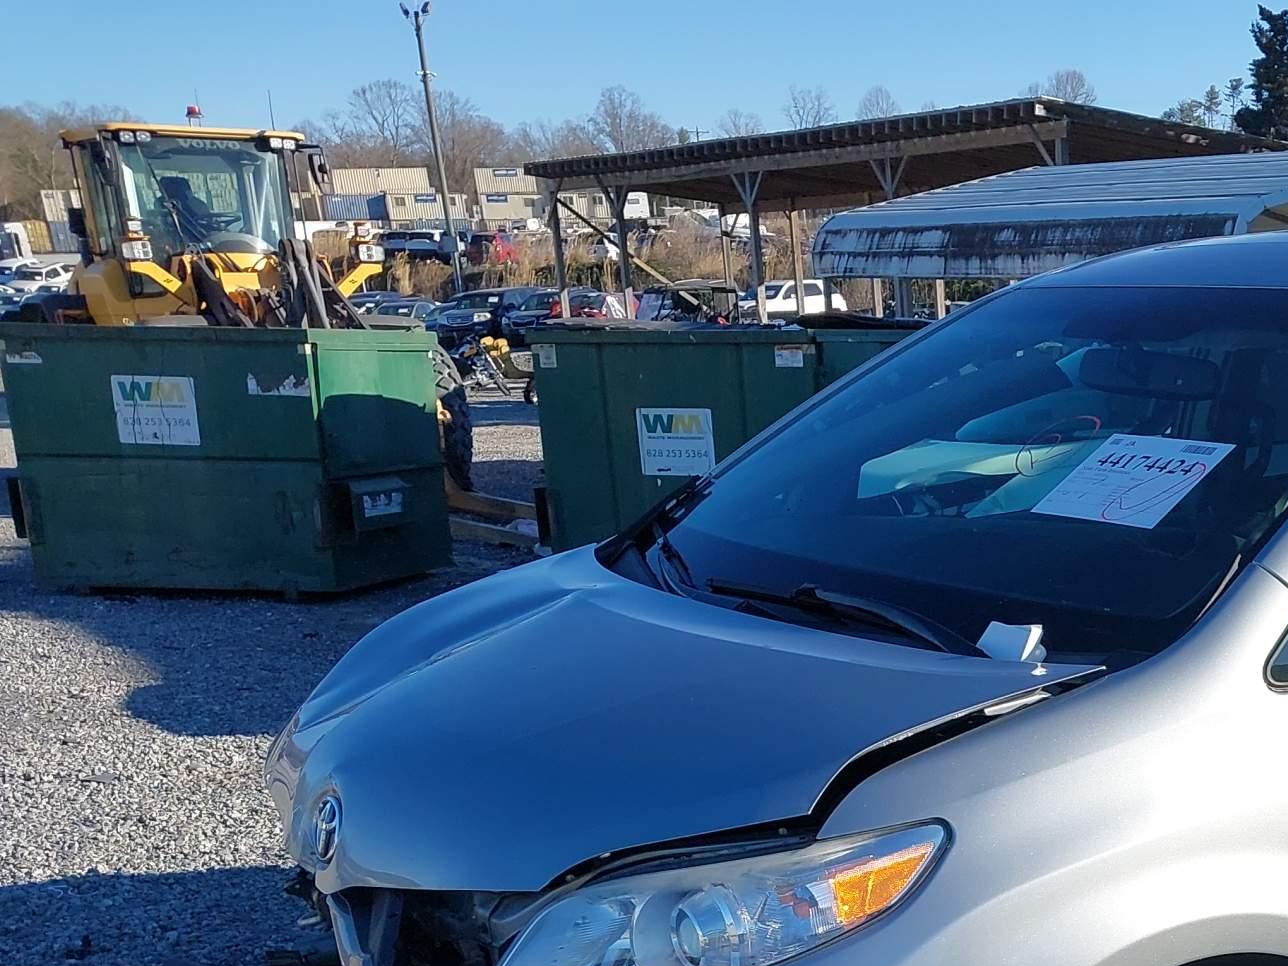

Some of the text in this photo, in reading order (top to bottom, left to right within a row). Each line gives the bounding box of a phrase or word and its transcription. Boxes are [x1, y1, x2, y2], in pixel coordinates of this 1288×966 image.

[176, 138, 241, 149] VOLVO
[117, 381, 185, 401] WM
[642, 413, 705, 434] WM
[646, 448, 709, 458] 828 253 5364
[1097, 452, 1199, 476] 44174424
